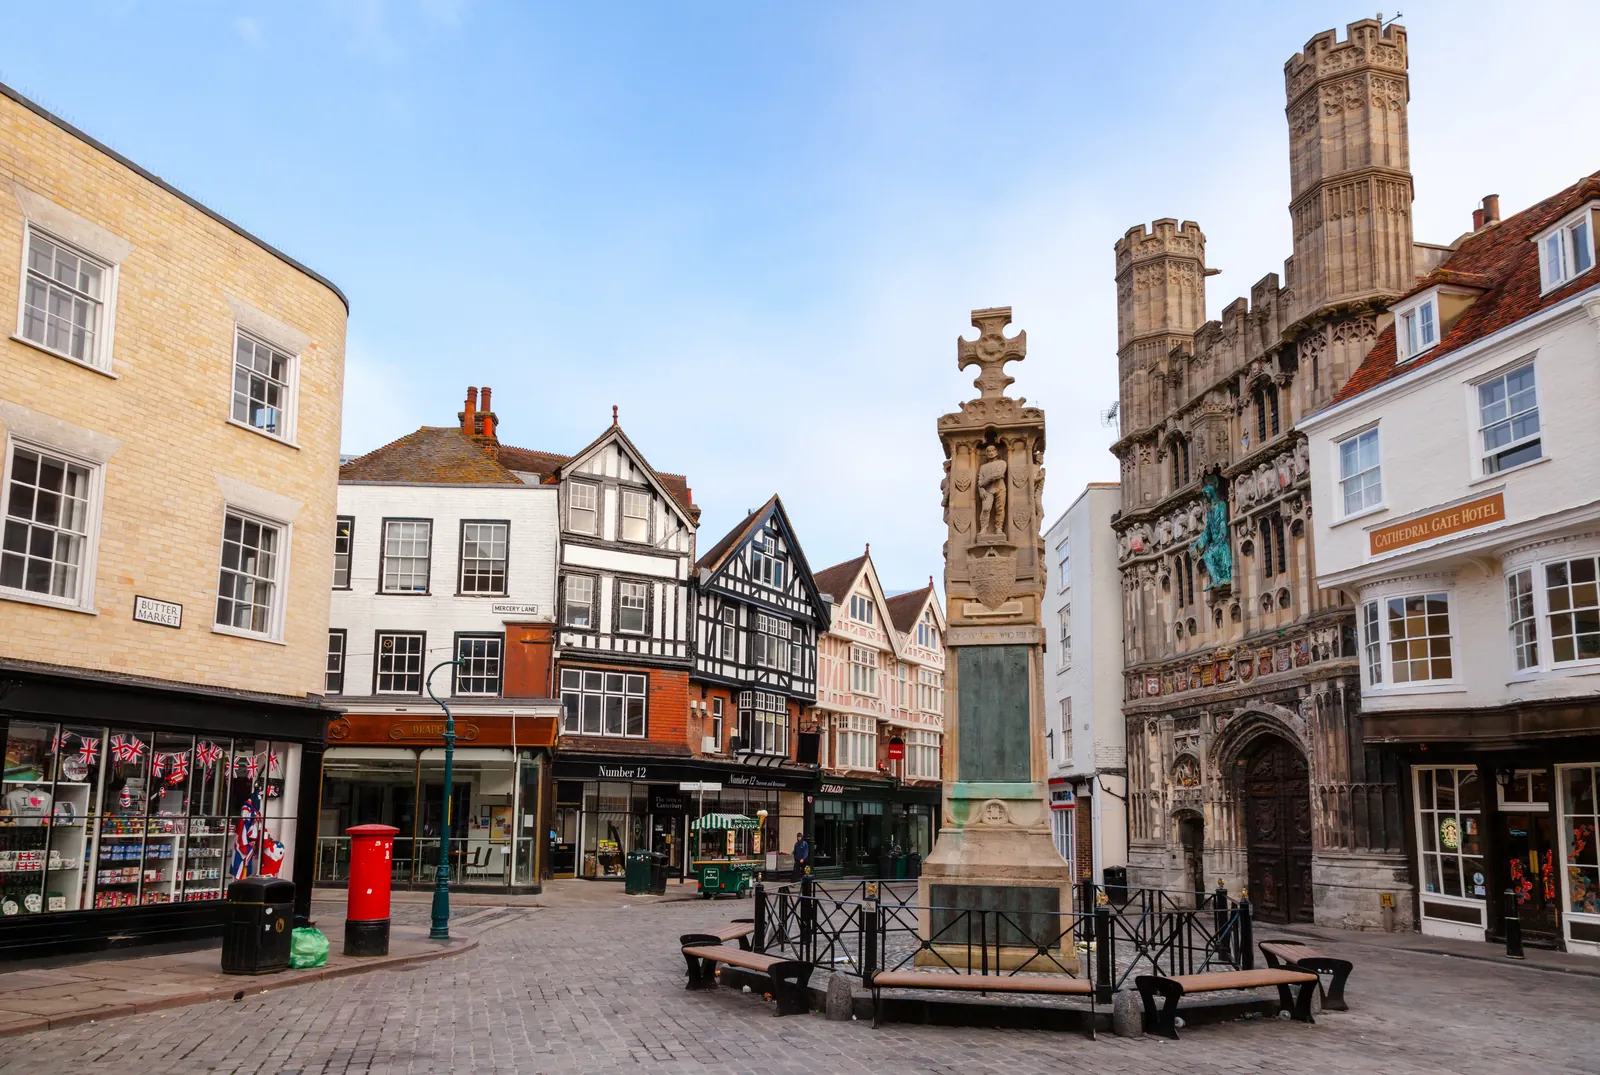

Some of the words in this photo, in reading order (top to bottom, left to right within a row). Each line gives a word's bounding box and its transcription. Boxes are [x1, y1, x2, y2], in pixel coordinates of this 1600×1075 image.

[1375, 525, 1430, 547] CATHEDRAL
[1432, 514, 1460, 532] GATE
[1462, 503, 1498, 523] HOTEL
[141, 600, 178, 615] BUTTER
[138, 610, 178, 624] MARKET
[598, 765, 634, 778] Number
[636, 766, 647, 778] 12
[728, 774, 748, 785] Number
[747, 775, 756, 785] 12
[820, 784, 844, 794] STRADA
